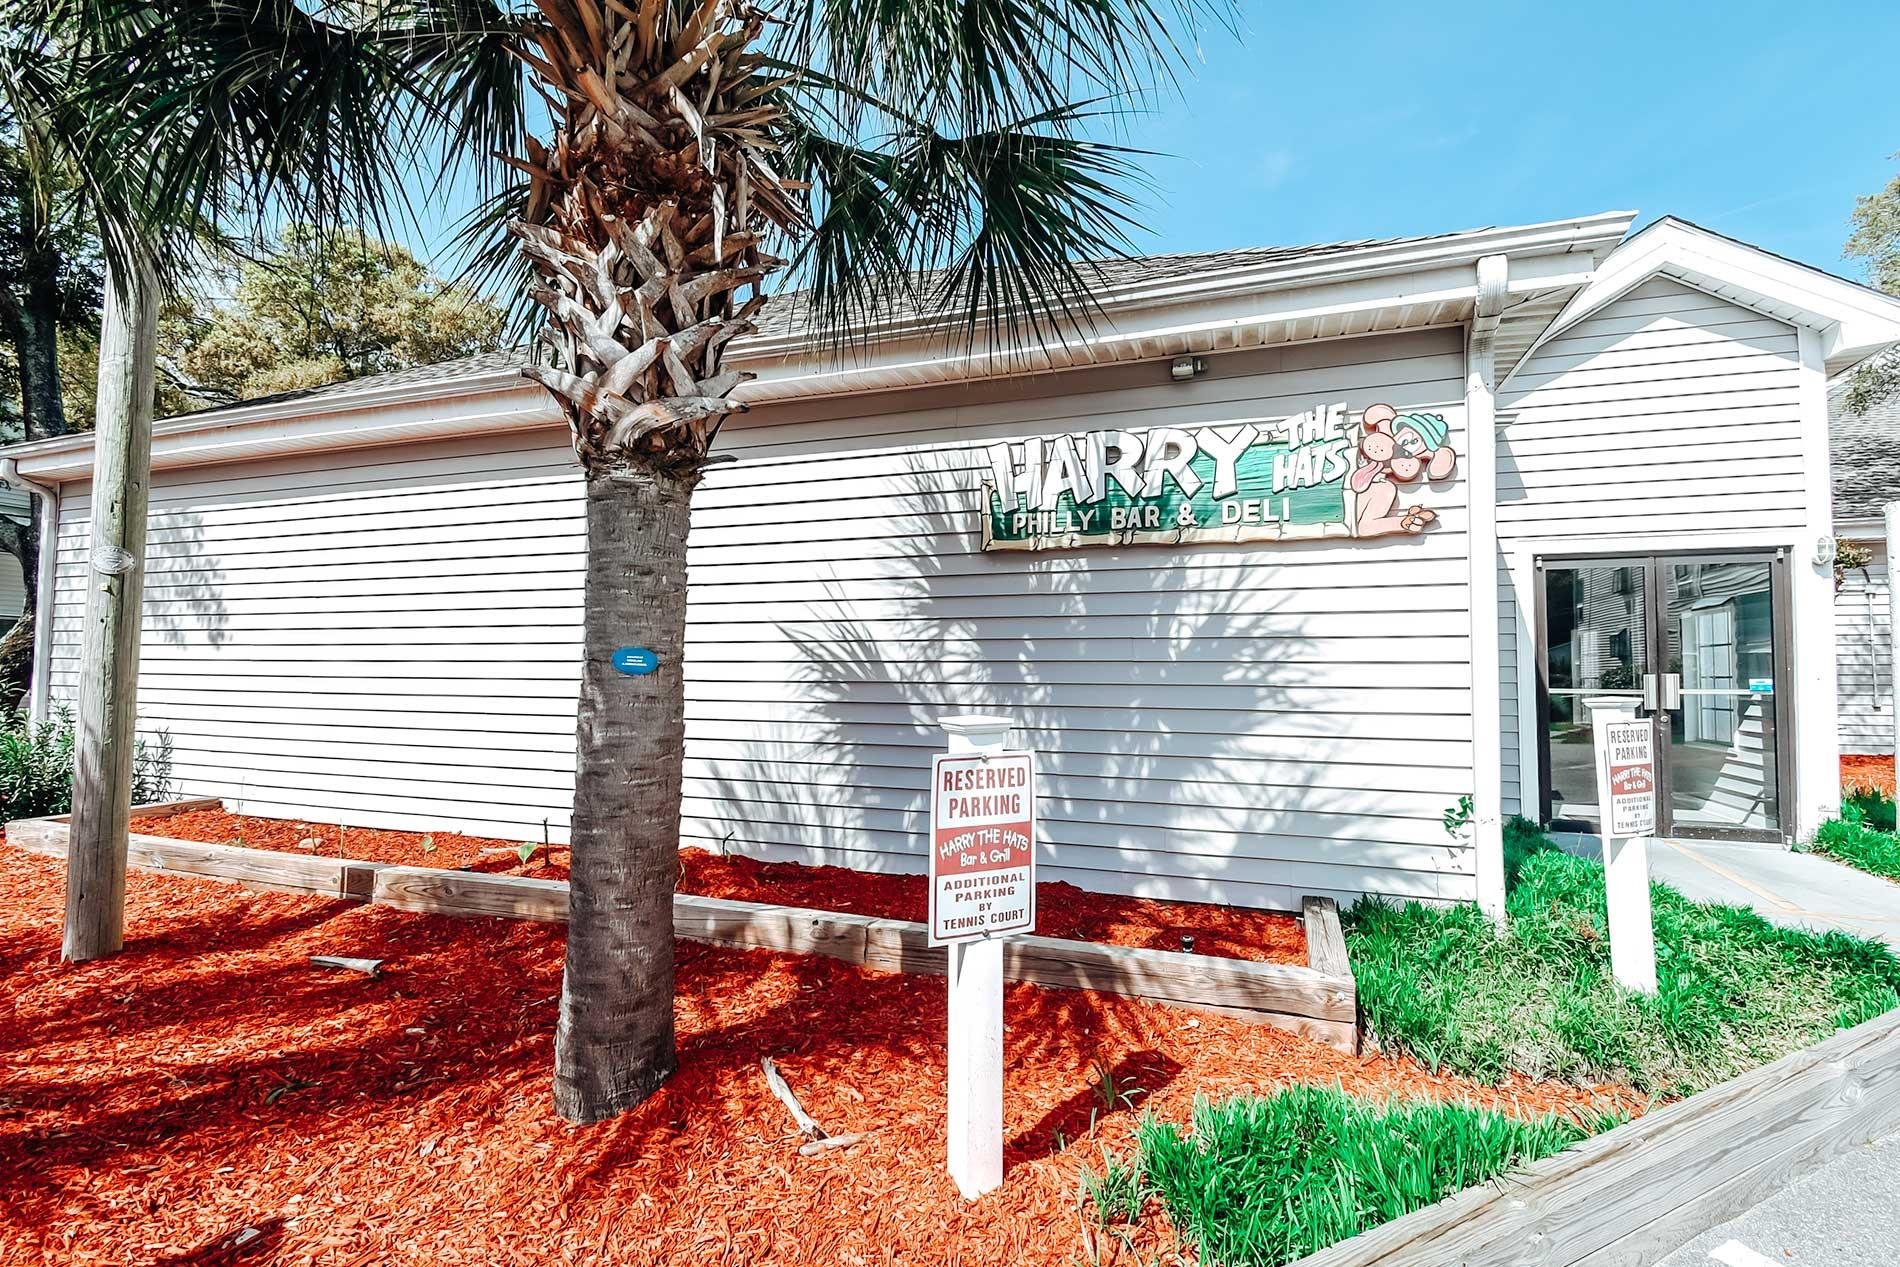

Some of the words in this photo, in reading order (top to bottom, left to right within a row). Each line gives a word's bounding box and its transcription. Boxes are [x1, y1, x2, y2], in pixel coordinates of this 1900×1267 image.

[1277, 402, 1348, 446] THE
[986, 424, 1261, 514] HARRY
[1271, 440, 1349, 494] HATS
[1012, 509, 1095, 536] PHILLY
[1111, 507, 1161, 531] BAR
[1177, 502, 1198, 527] &
[1221, 498, 1291, 525] DELI
[1610, 729, 1649, 744] RESERVED
[1615, 745, 1647, 761] PARKING
[943, 767, 1026, 792] RESERVED
[948, 793, 1021, 819] PARKING
[939, 831, 976, 861] HARRY
[976, 828, 1000, 846] THE
[1002, 829, 1029, 852] HATS
[960, 851, 978, 867] Bar
[979, 850, 988, 865] &
[989, 847, 1011, 864] Grill
[943, 872, 1025, 891] ADDITIONAL
[955, 886, 1015, 903] PARKING
[979, 902, 992, 912] BY
[943, 914, 985, 931] TENNIS
[990, 908, 1025, 924] COURT
